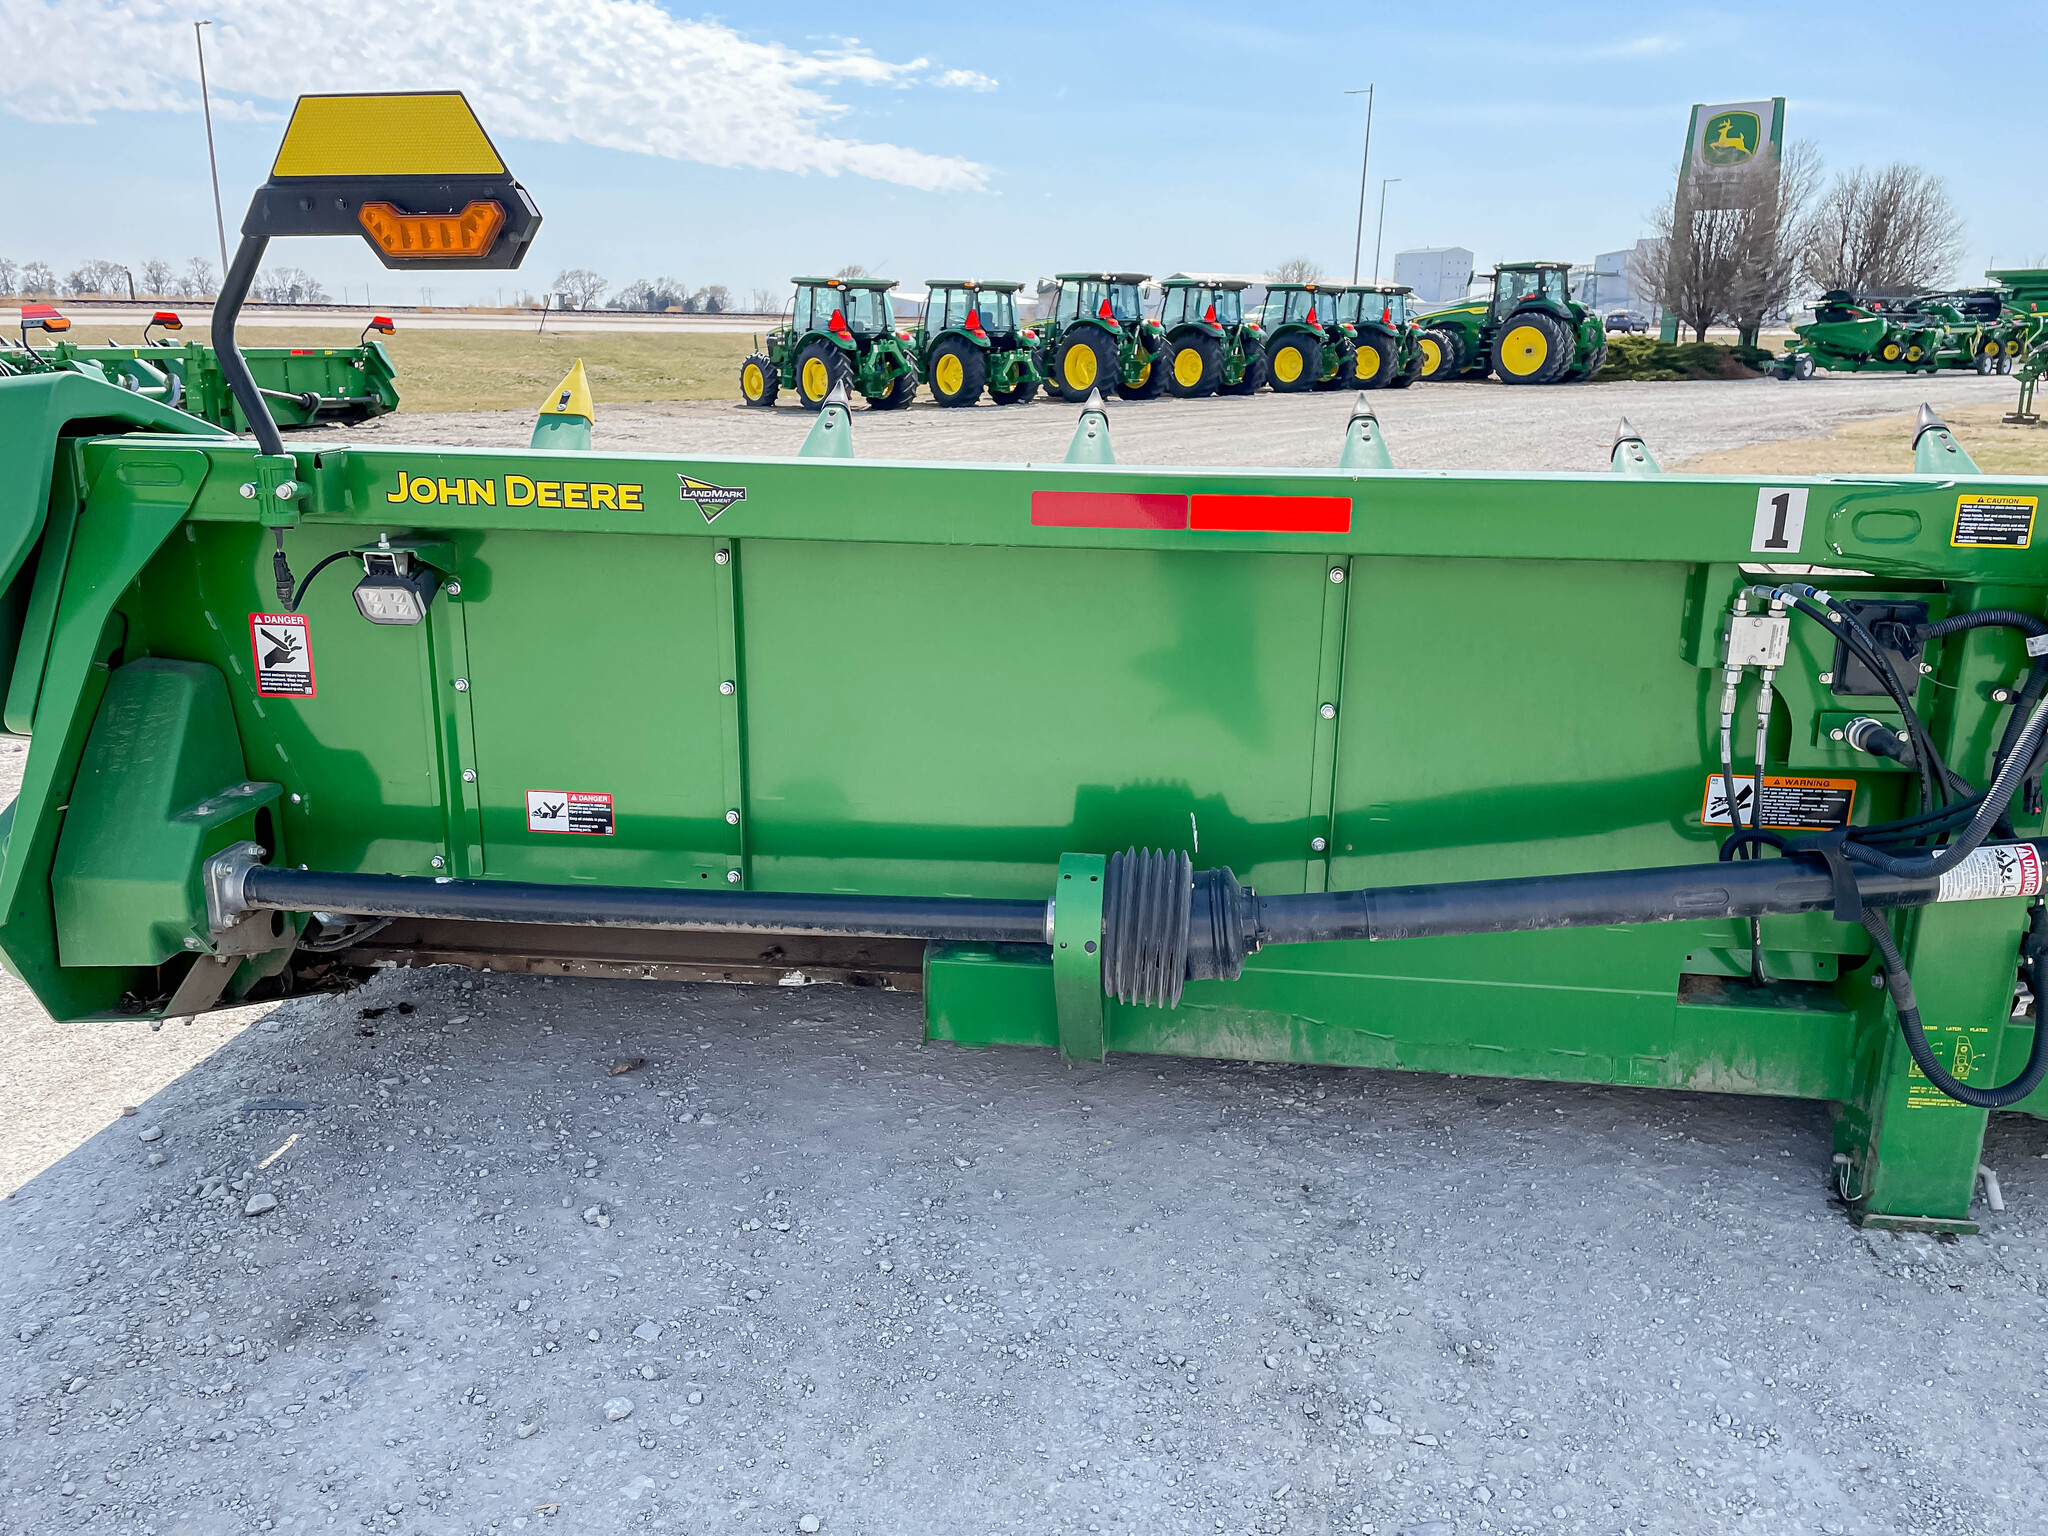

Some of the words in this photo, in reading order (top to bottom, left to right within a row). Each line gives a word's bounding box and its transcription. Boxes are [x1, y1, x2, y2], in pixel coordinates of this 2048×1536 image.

[386, 470, 496, 506] JOHN
[504, 474, 645, 512] DEERE
[1764, 493, 1790, 548] 1
[264, 615, 304, 624] DANGER
[1785, 779, 1830, 787] WARNING
[2022, 859, 2037, 895] DANGE
